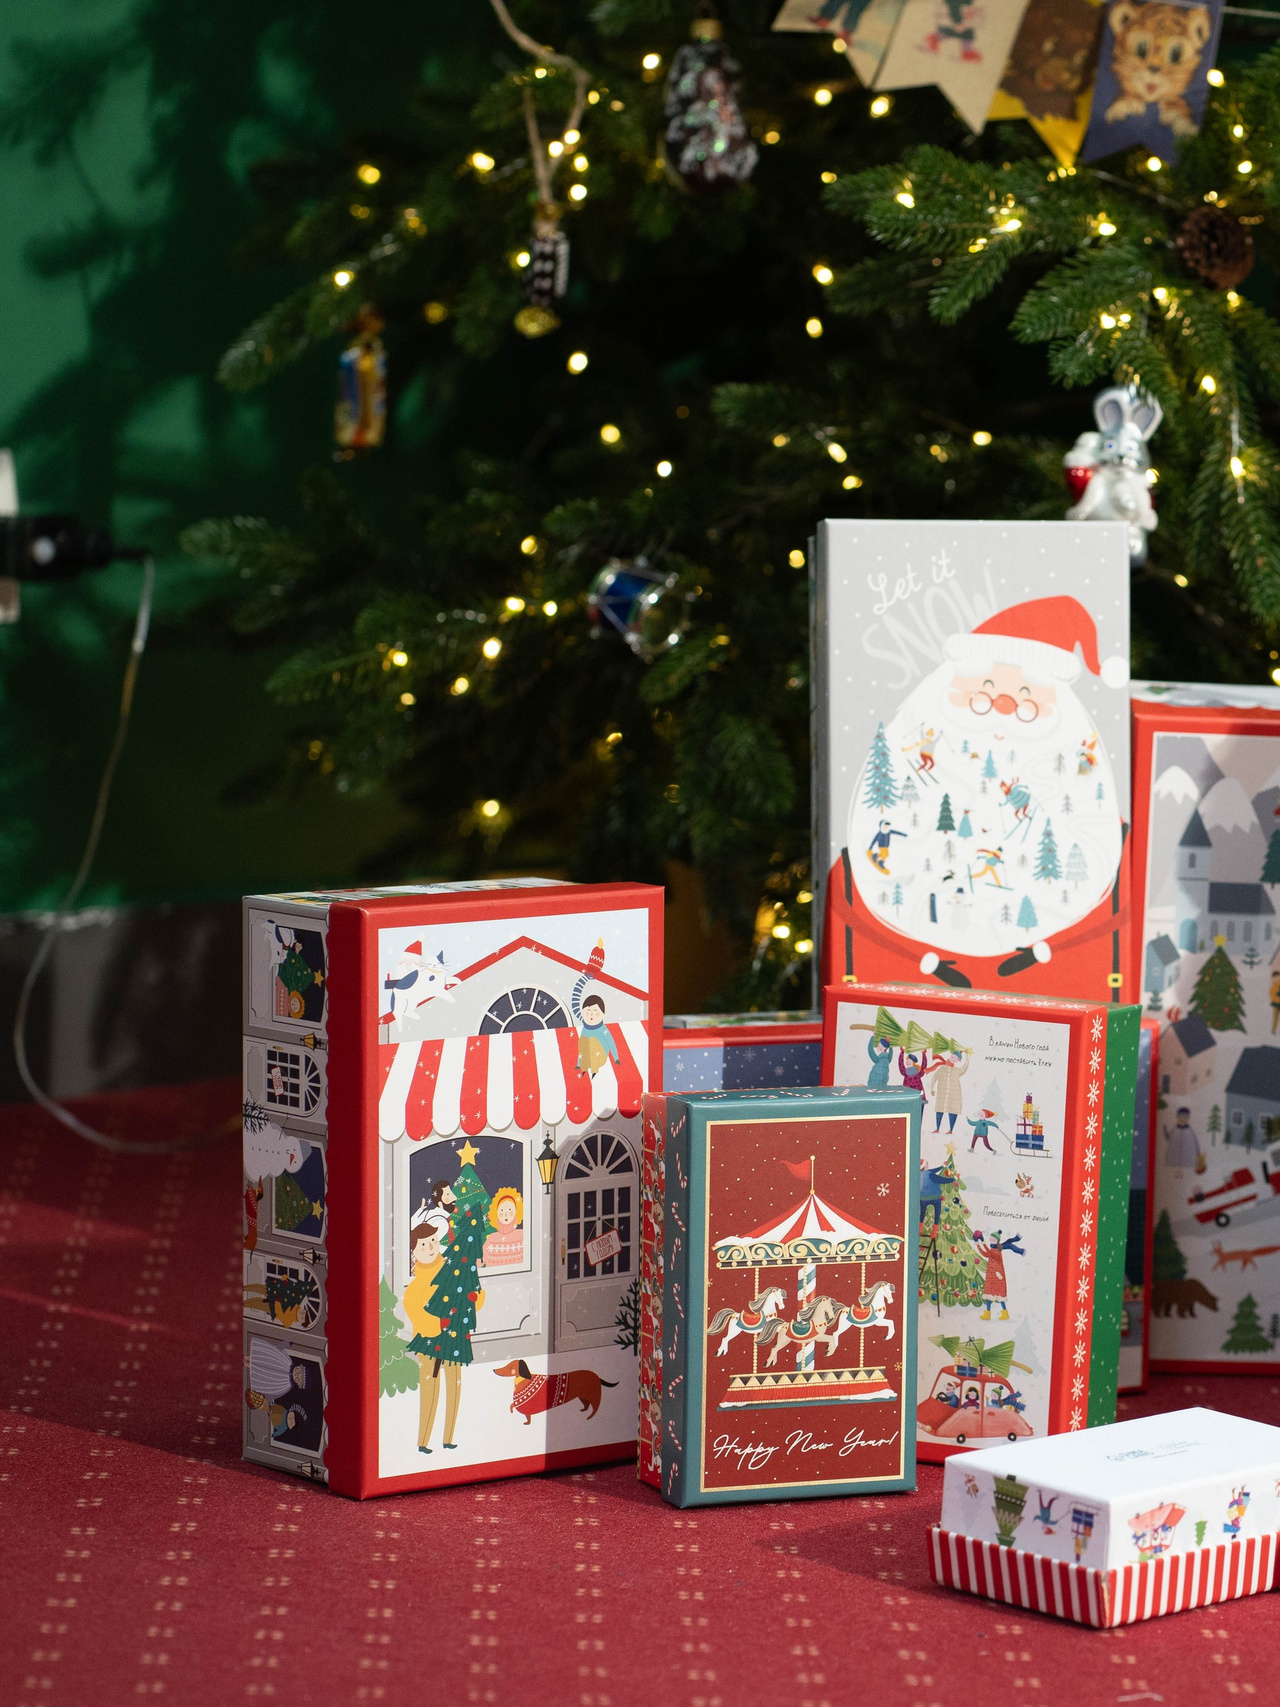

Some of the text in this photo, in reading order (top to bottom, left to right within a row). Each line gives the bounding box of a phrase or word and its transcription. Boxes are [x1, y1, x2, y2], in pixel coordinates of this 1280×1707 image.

[867, 548, 957, 616] Let it
[712, 1426, 899, 1471] Happy New Year!
